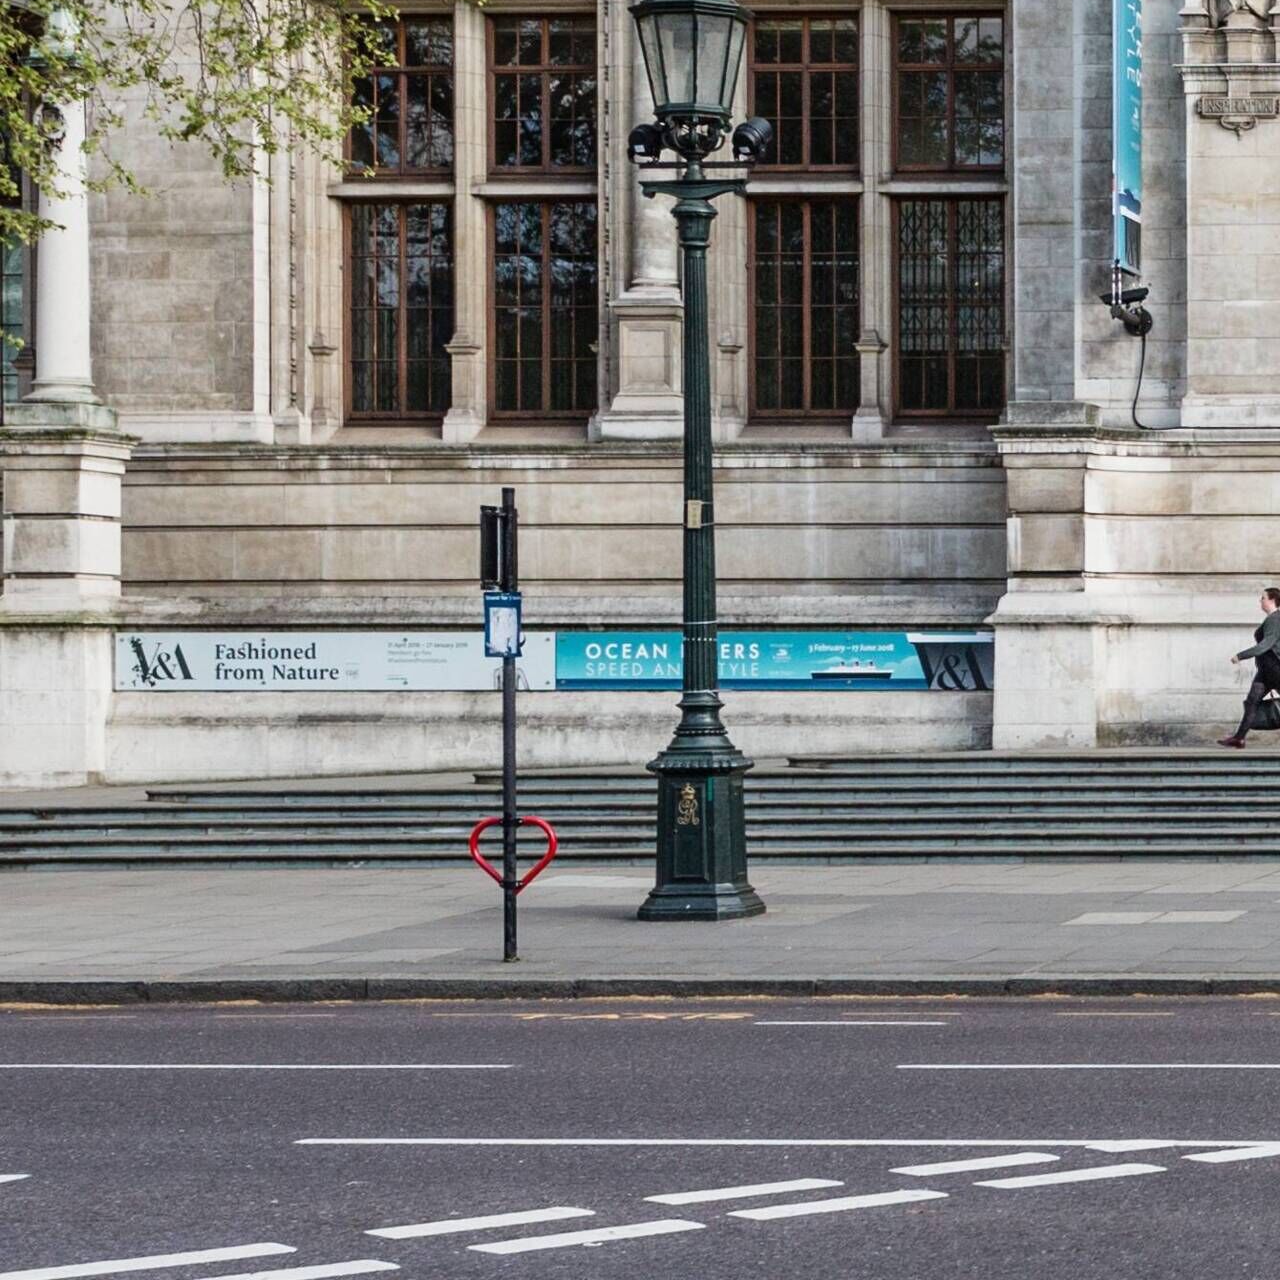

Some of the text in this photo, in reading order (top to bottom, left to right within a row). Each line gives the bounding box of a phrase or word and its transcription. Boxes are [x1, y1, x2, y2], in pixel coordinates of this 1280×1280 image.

[214, 642, 317, 660] Fashioned
[585, 643, 668, 660] OCEAN
[814, 643, 845, 652] February
[859, 643, 875, 652] June
[130, 639, 196, 684] V&A
[585, 663, 643, 677] SPEED
[652, 663, 684, 677] AN
[718, 663, 760, 677] TYLE
[913, 642, 990, 690] V&A
[215, 663, 264, 680] from
[272, 664, 339, 680] Nature
